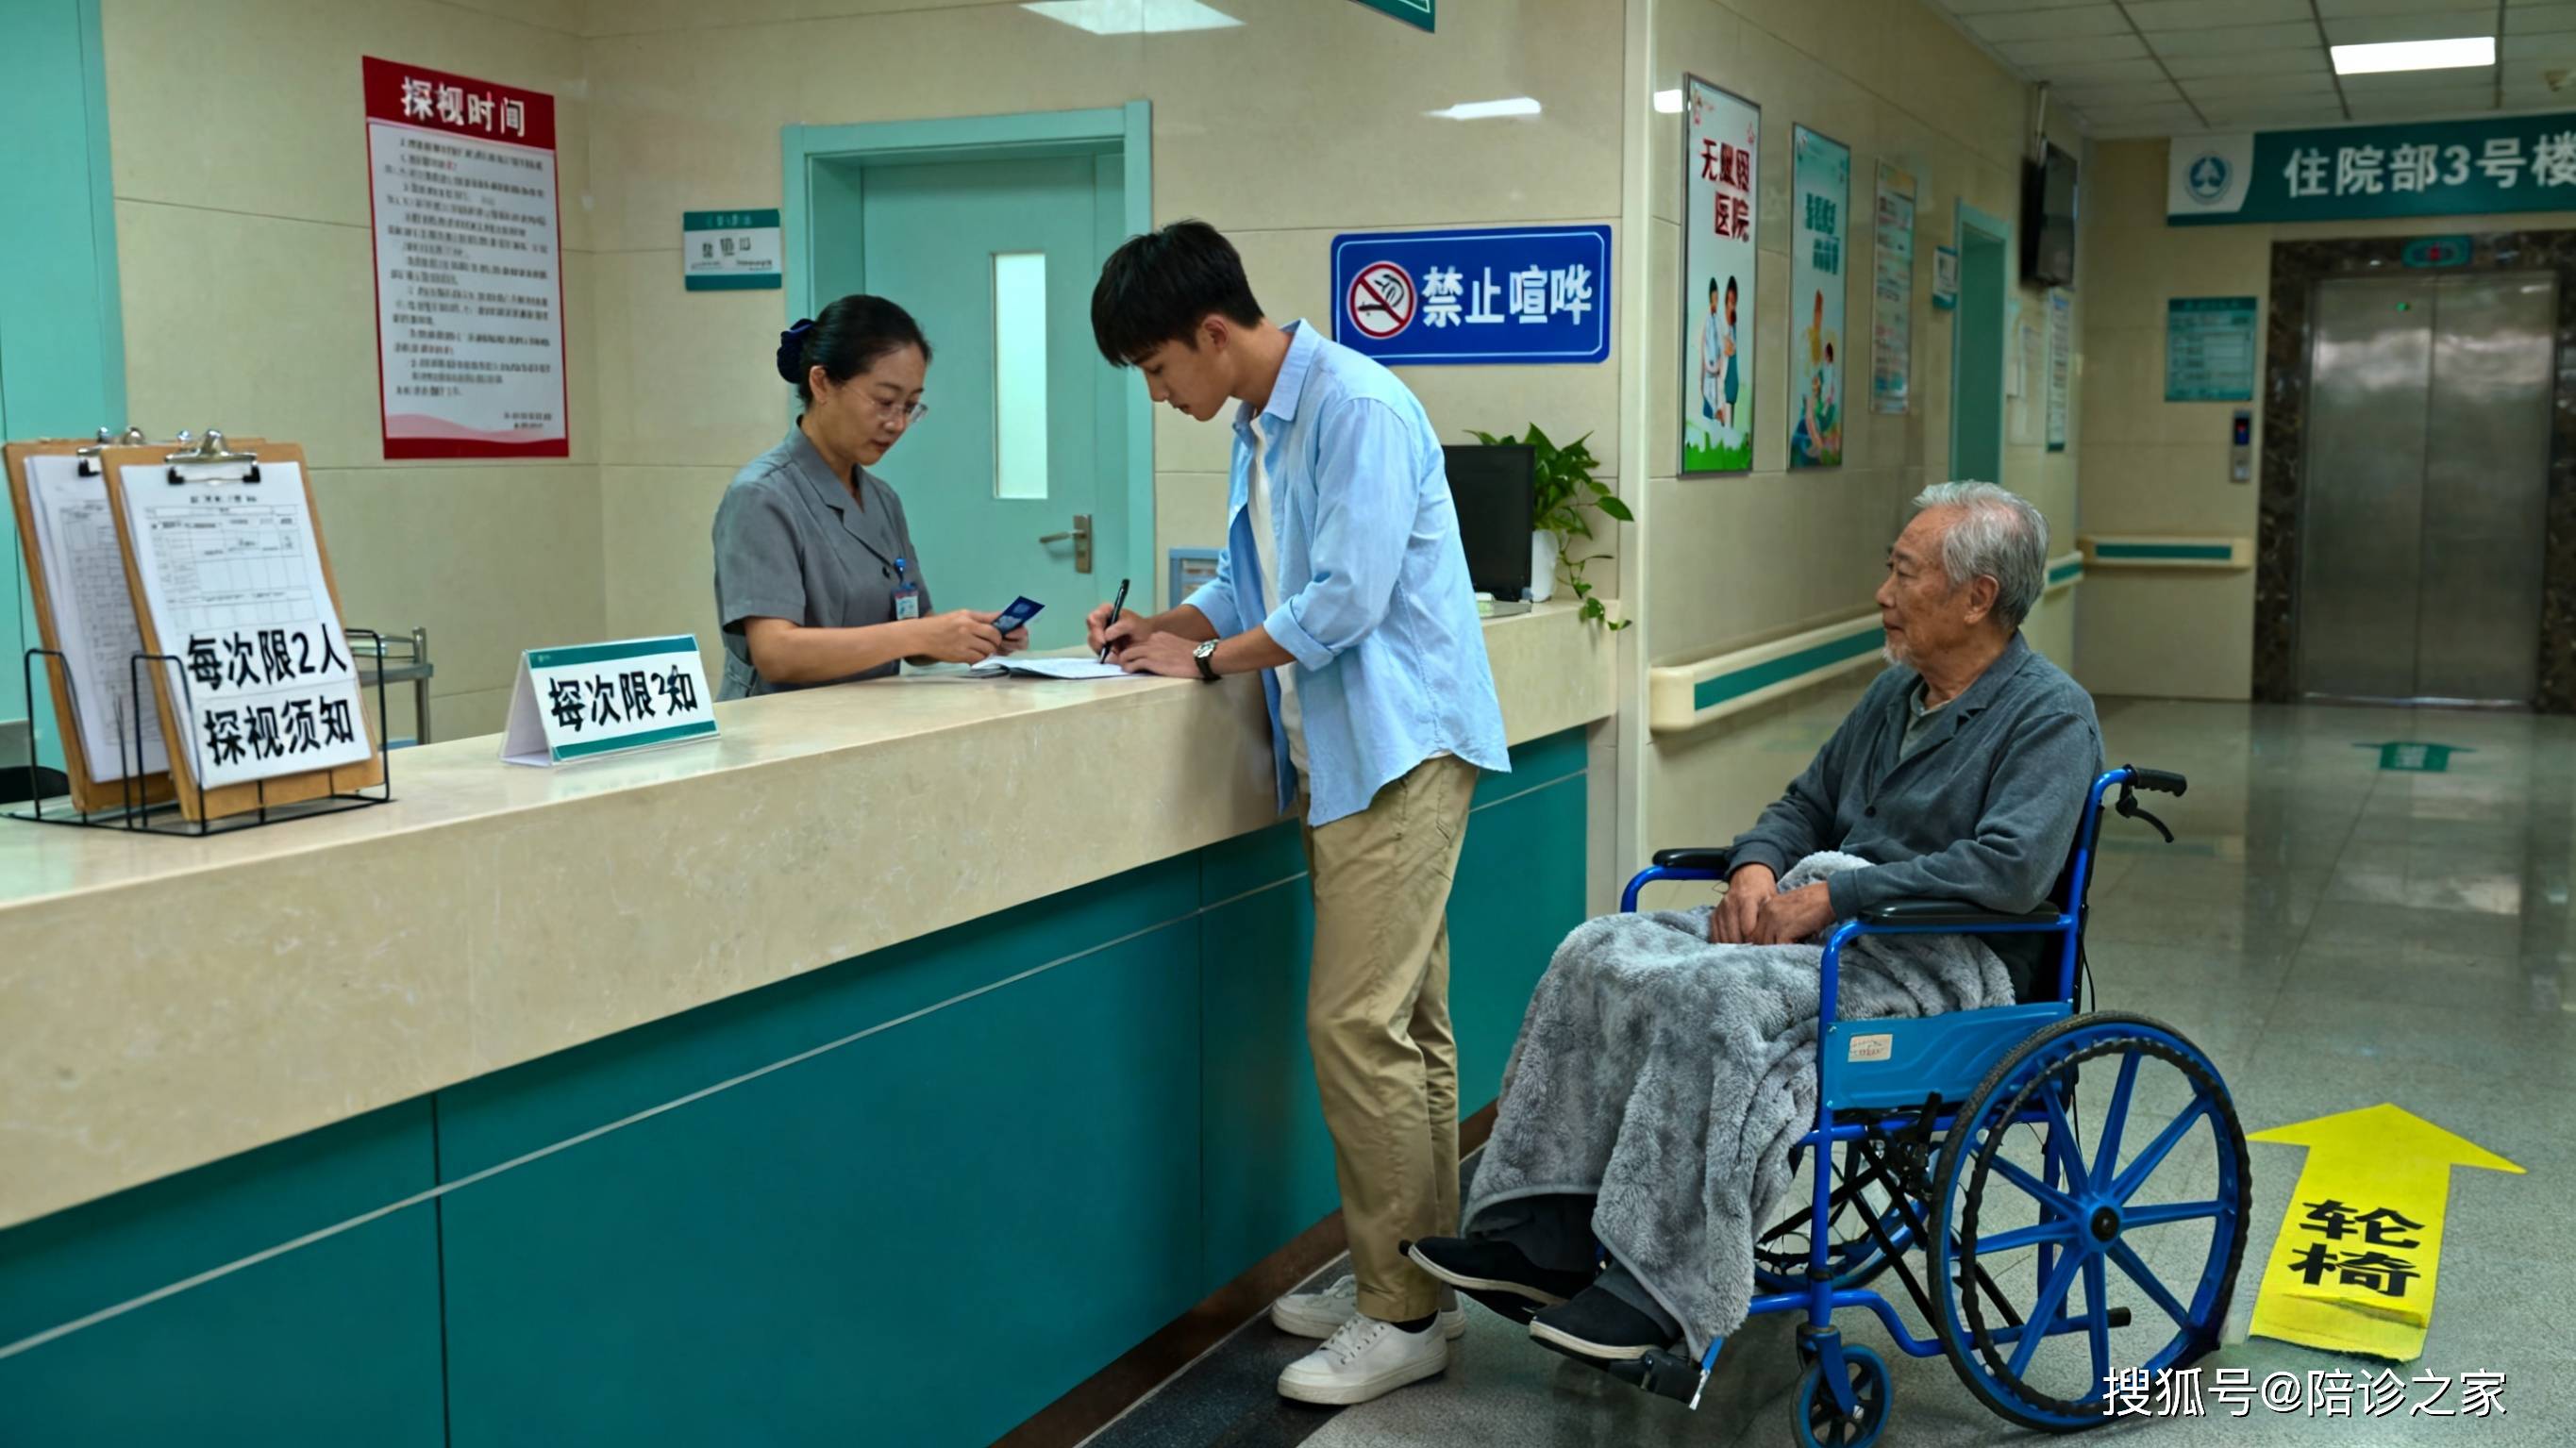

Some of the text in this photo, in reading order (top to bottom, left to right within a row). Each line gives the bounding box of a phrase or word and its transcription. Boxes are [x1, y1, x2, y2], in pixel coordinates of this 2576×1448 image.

[400, 75, 526, 138] 探视时间
[2283, 130, 2576, 198] 住院部3号楼
[1421, 263, 1593, 329] 禁止喧哗
[186, 623, 348, 691] 每次限2人
[203, 695, 355, 767] 探视须知
[2288, 1199, 2426, 1298] 轮椅
